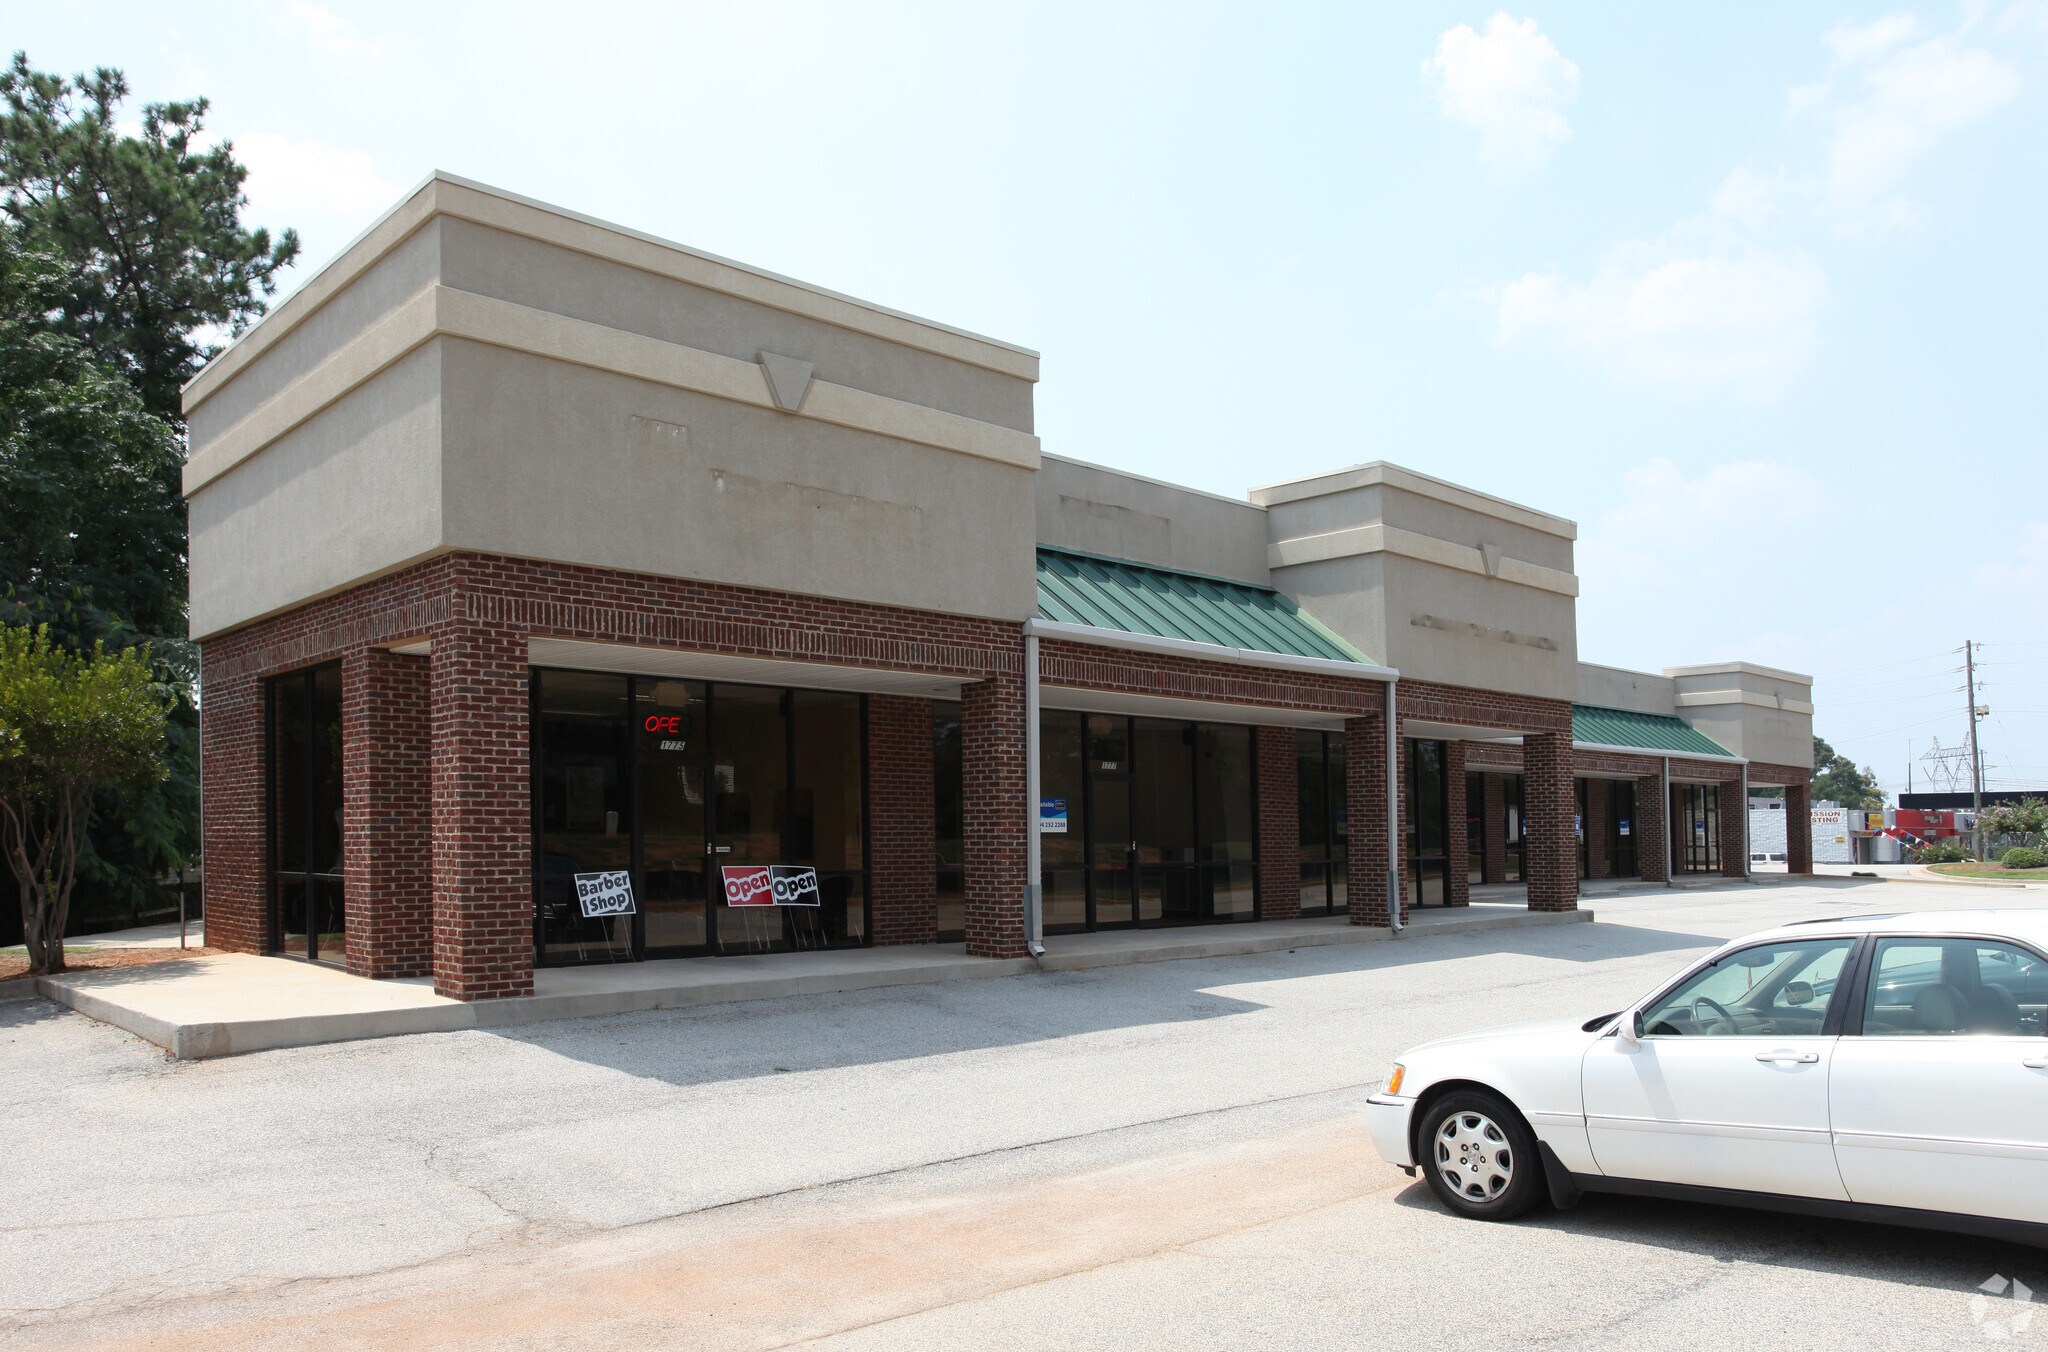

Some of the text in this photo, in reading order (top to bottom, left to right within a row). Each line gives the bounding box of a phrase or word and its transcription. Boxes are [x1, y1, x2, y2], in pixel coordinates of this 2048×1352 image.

[661, 741, 685, 750] 1775
[578, 874, 628, 897] Barber
[726, 874, 770, 898] Open
[774, 875, 816, 897] Open
[589, 893, 626, 912] Shop
